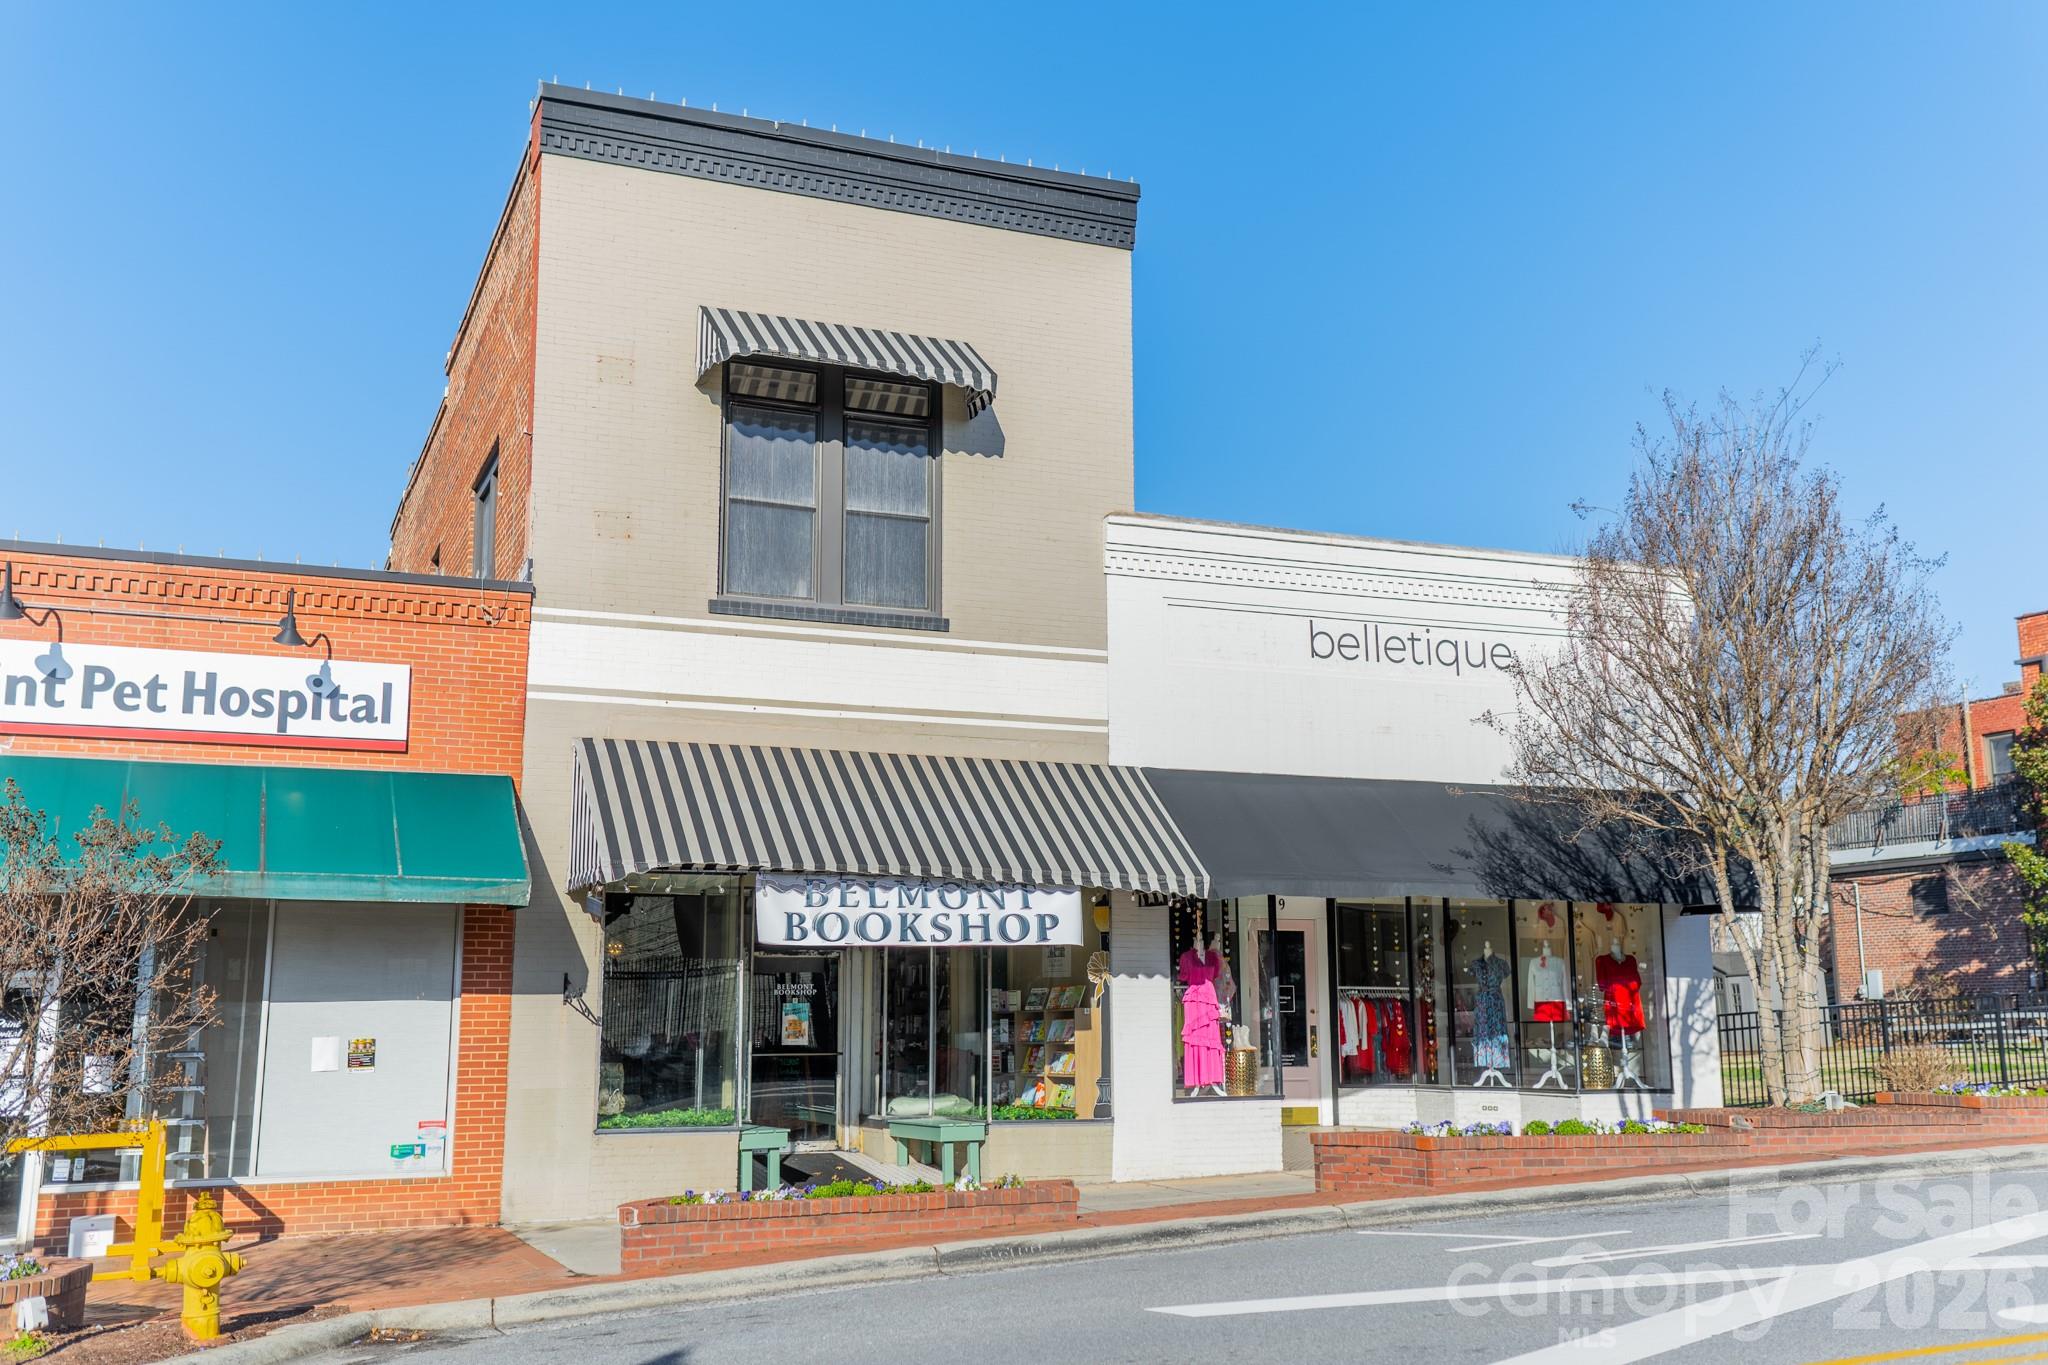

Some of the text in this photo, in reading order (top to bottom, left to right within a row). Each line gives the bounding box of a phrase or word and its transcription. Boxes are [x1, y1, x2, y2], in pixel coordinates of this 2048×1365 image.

[1309, 619, 1513, 677] belletique
[0, 661, 393, 734] nt Pet Hospital
[803, 877, 1037, 911] BELMONT
[1278, 898, 1286, 910] 9
[783, 910, 1060, 944] BOOKSHOP
